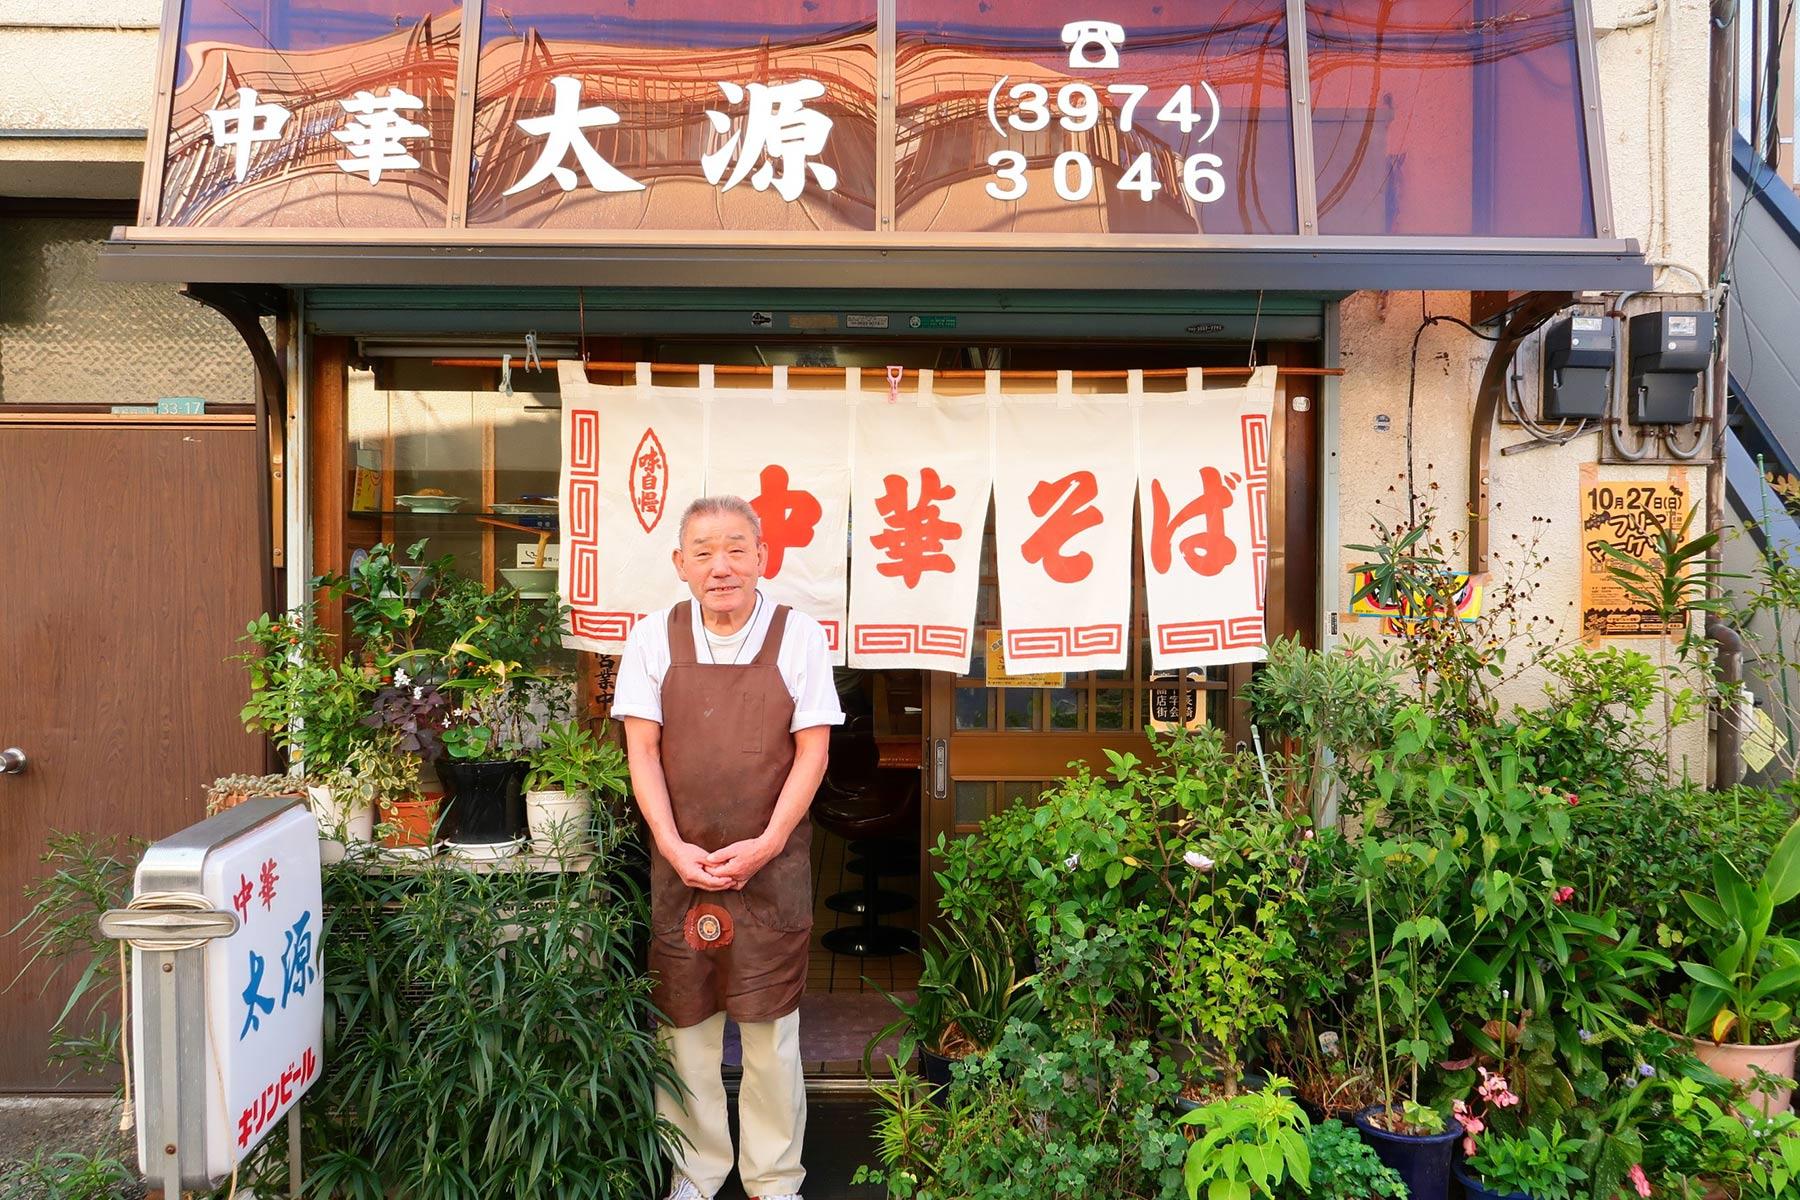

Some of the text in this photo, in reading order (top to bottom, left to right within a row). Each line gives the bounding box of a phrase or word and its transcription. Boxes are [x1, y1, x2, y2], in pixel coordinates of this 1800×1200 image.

[204, 76, 838, 203] 中華 太源
[987, 75, 1221, 143] (3974)
[985, 150, 1226, 203] 3046
[160, 402, 201, 415] 33-17
[638, 445, 662, 514] 味自慢
[1587, 487, 1682, 511] 10月27日(日)
[749, 464, 1242, 589] 中華そば
[233, 857, 280, 924] 中華
[239, 910, 315, 1042] 太源
[237, 1046, 316, 1149] キリンビール
